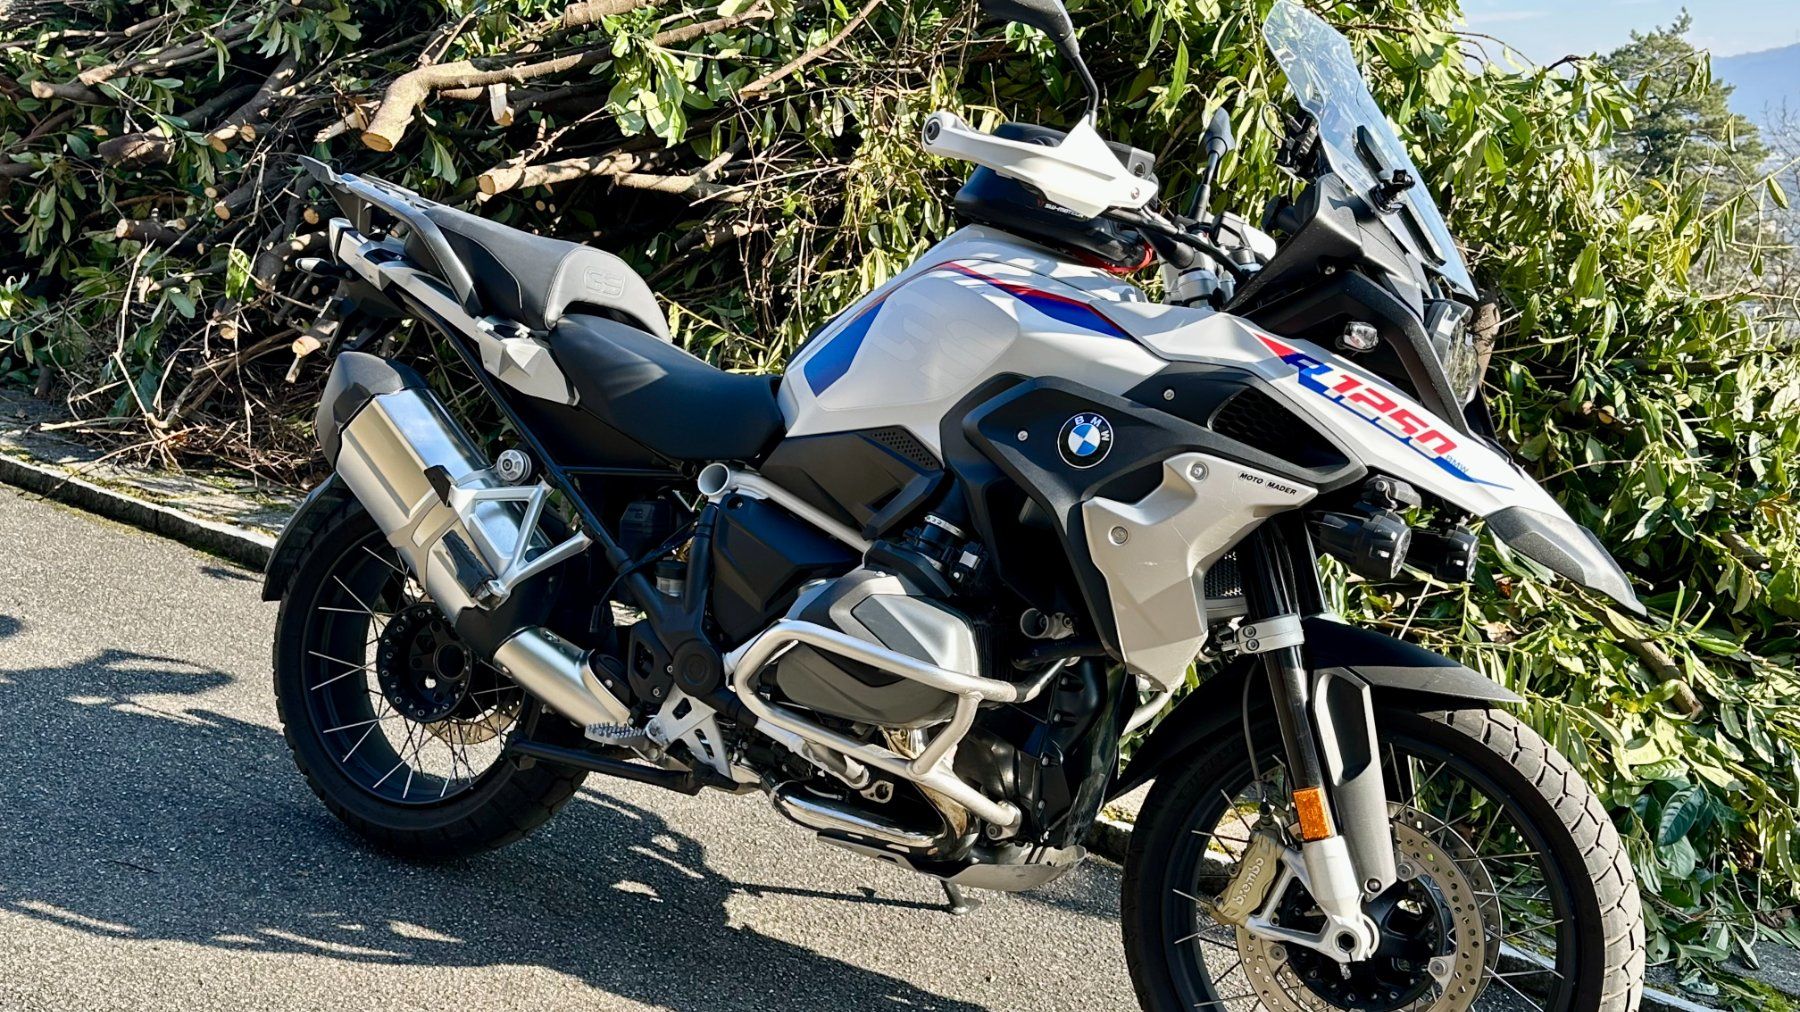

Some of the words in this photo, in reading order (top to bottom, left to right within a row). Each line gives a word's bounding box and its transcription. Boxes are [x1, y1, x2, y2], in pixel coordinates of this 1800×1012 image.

[1074, 415, 1110, 442] BMW
[1239, 472, 1264, 485] MOTO
[1267, 481, 1297, 496] MADER
[1232, 857, 1264, 906] brembo
